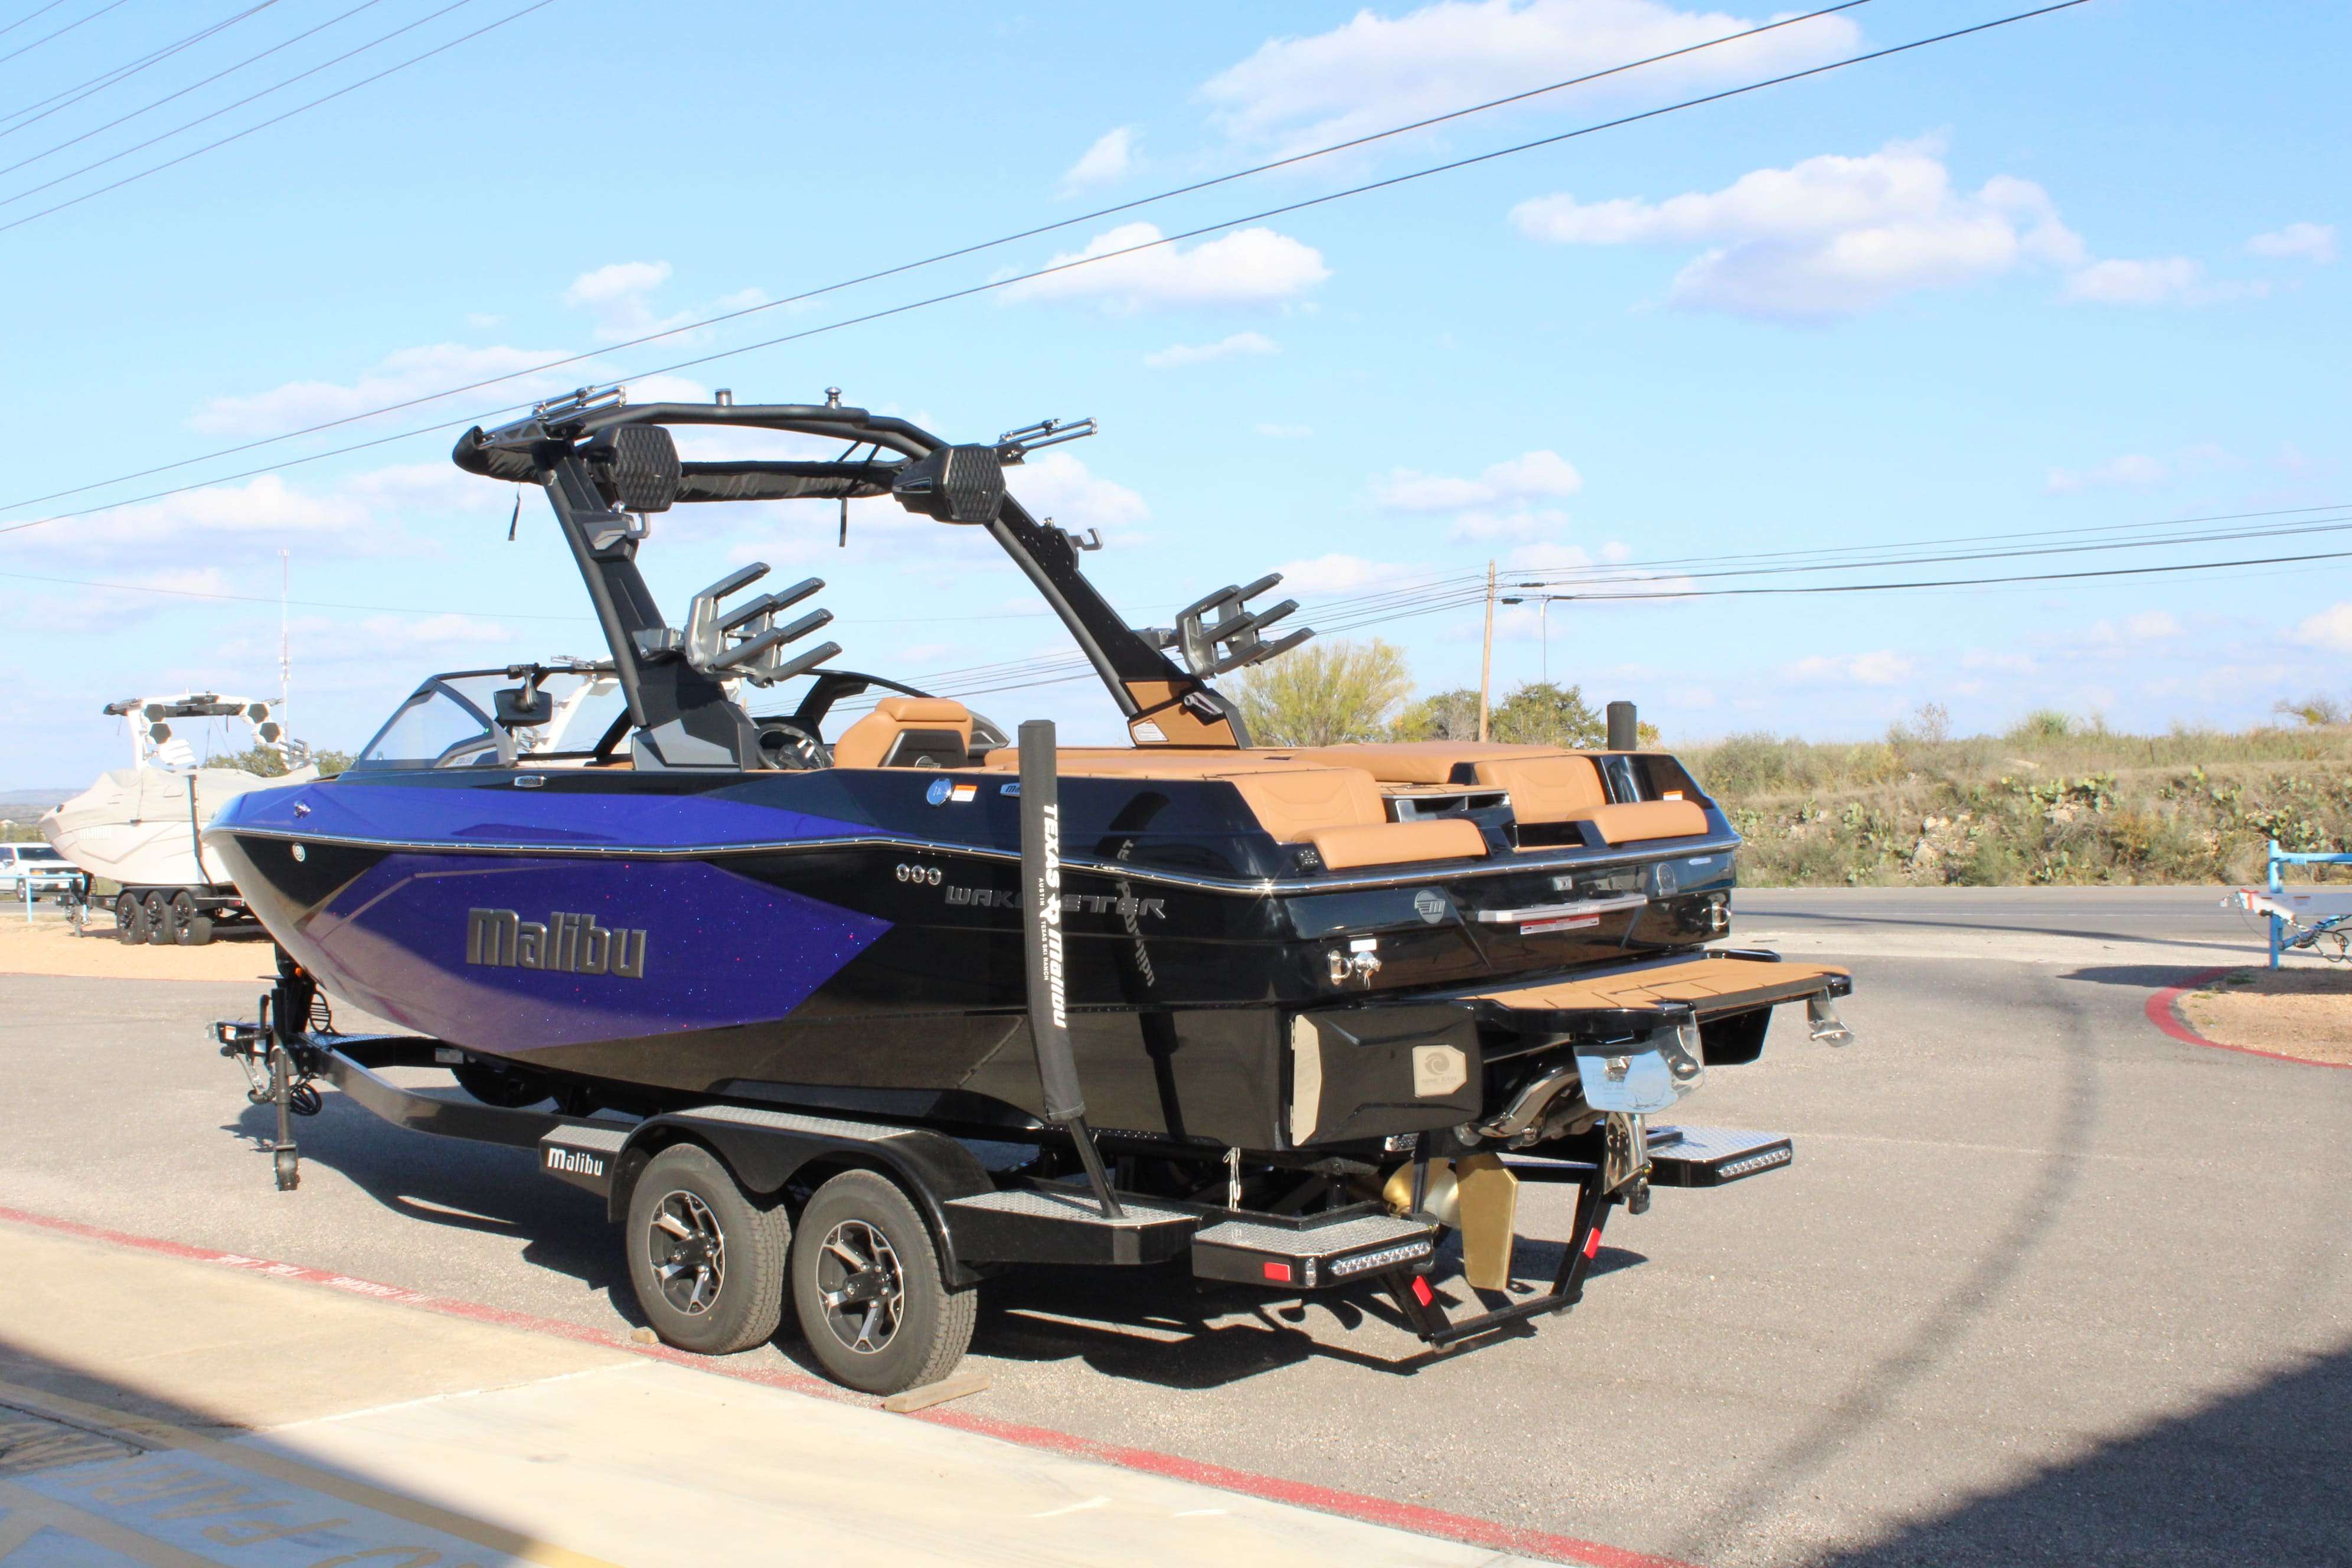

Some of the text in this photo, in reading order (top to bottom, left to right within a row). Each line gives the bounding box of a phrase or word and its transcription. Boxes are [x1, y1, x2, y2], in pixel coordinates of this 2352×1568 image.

[1044, 804, 1060, 888] TEXAS
[945, 886, 1165, 919] WAKETTER
[466, 907, 647, 979] Malibu
[548, 1148, 603, 1176] Malibu
